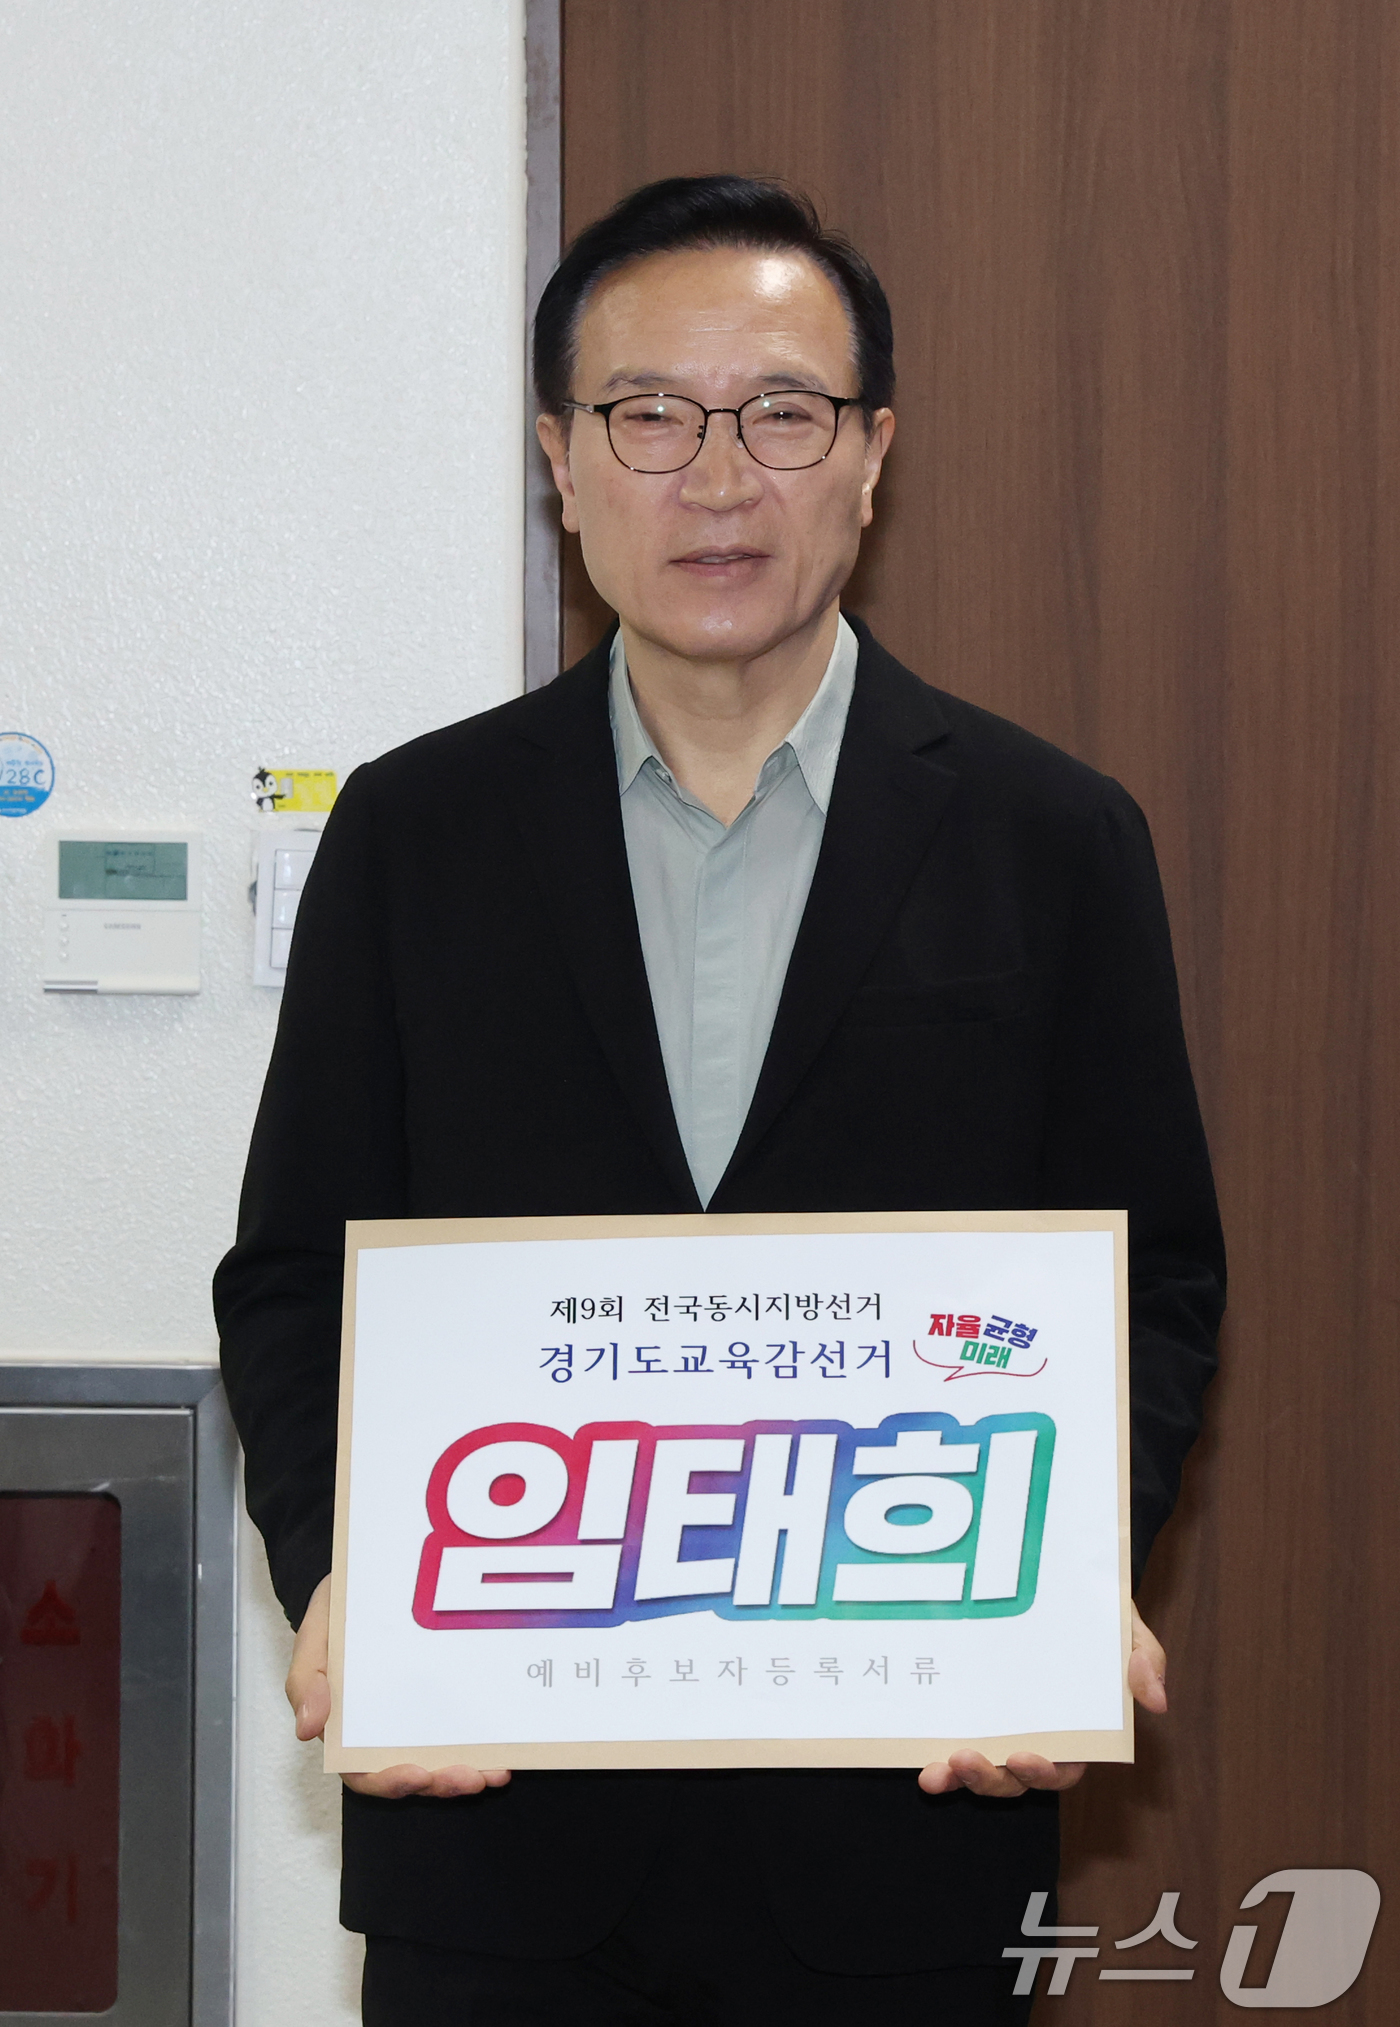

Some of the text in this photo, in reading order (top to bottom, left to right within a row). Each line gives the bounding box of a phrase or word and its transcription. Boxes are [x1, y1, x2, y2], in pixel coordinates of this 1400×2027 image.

[550, 1293, 883, 1326] 제9회 전국동시지방선거
[927, 1313, 1038, 1350] 자율 균형
[538, 1340, 892, 1384] 경기도교육감선거
[959, 1340, 1012, 1369] 미래
[430, 1429, 1040, 1613] 임태희
[526, 1655, 942, 1689] 예비후보자등록서류
[20, 1579, 82, 1925] 소화기
